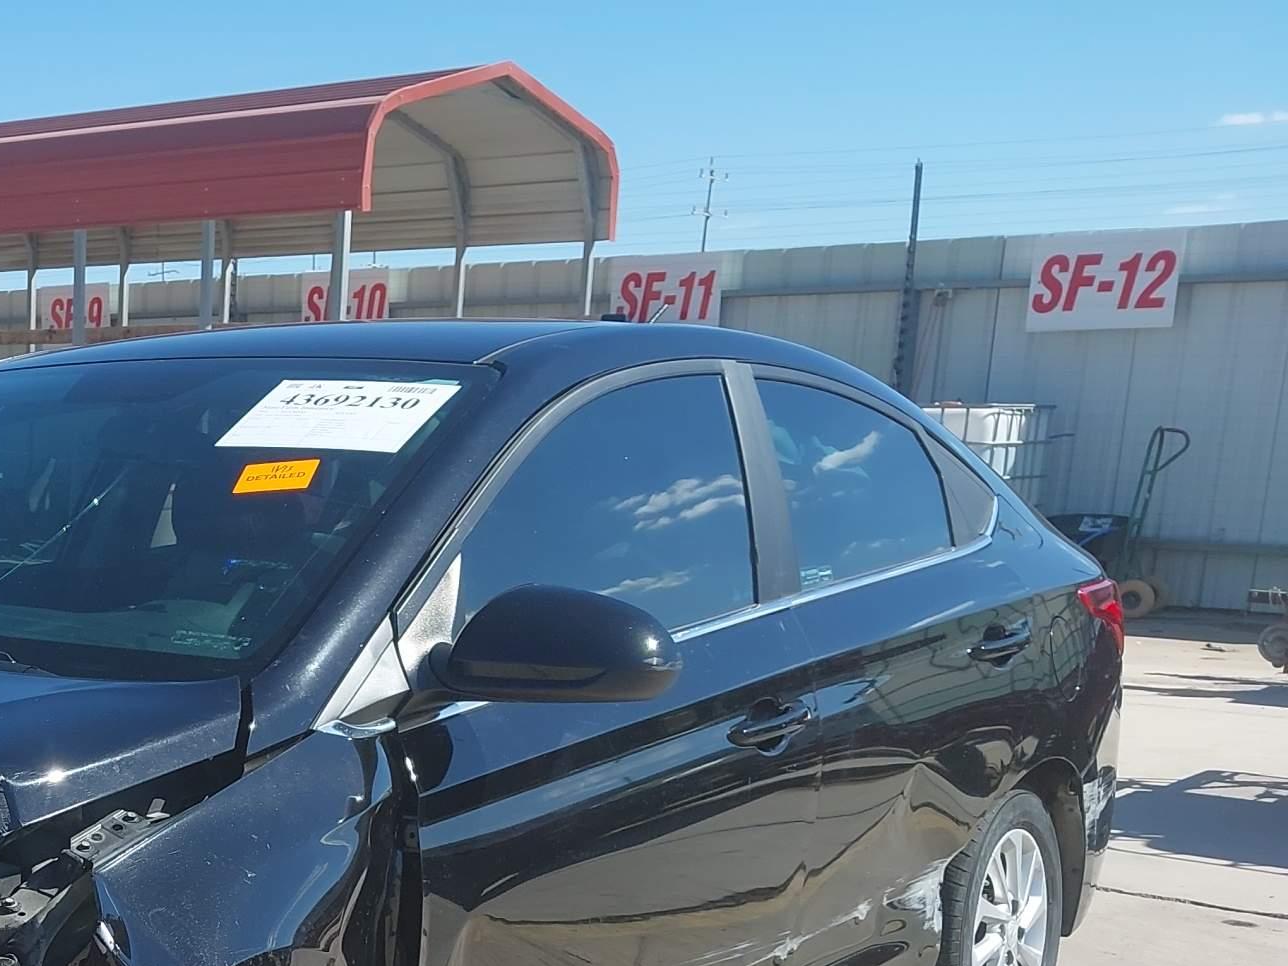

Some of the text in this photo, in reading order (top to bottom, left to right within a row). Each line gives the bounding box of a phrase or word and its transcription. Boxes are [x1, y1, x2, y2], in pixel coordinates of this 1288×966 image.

[616, 270, 716, 323] SF-11
[1031, 249, 1177, 314] SF-12
[50, 296, 103, 329] SF9
[304, 283, 387, 322] S-10
[280, 393, 421, 410] 43692130
[246, 471, 306, 482] DETAILED
